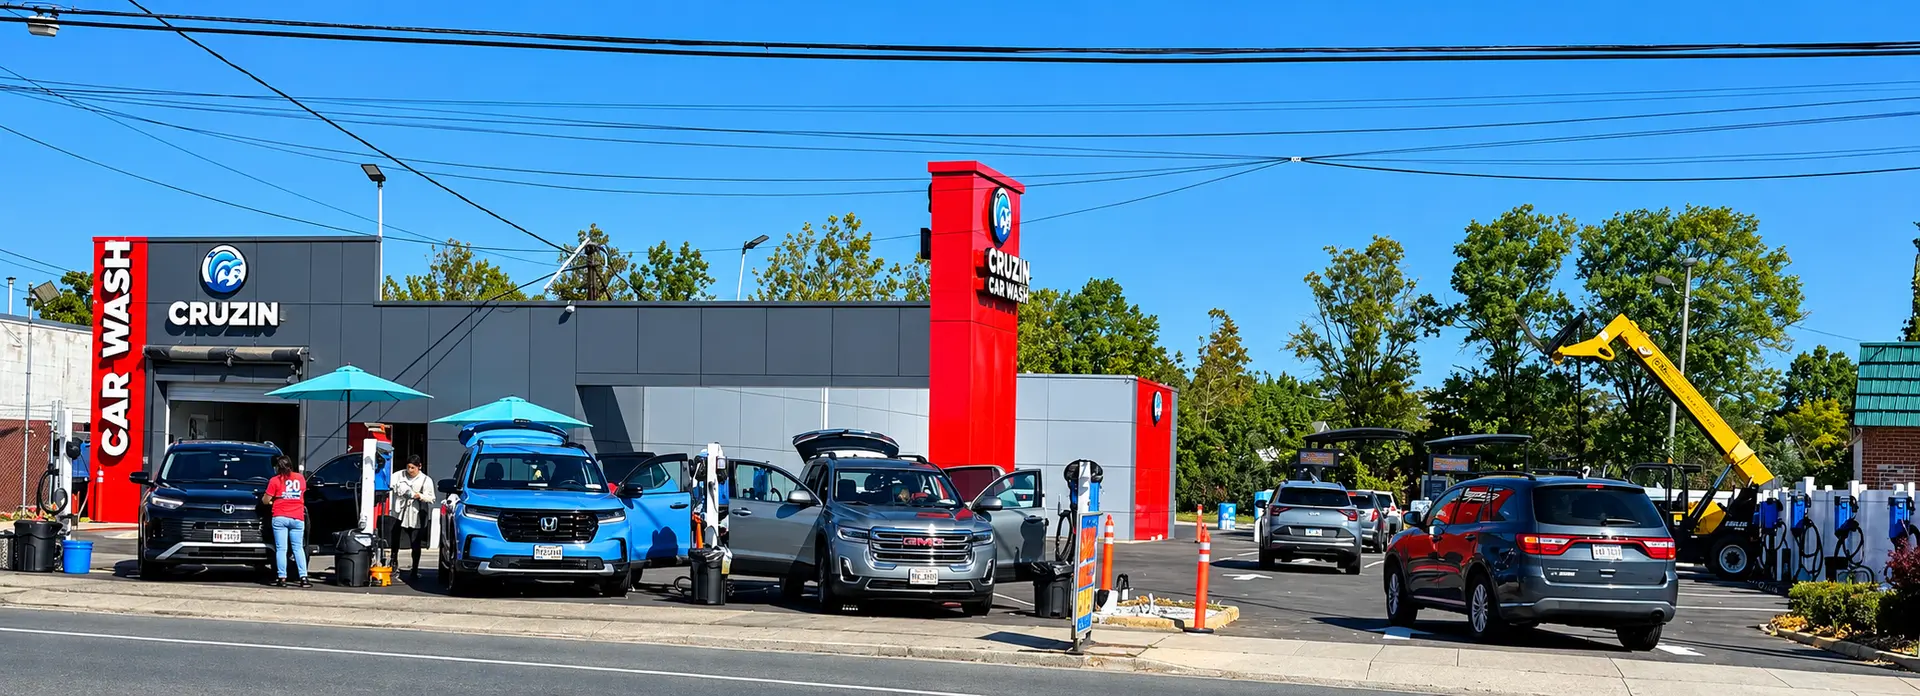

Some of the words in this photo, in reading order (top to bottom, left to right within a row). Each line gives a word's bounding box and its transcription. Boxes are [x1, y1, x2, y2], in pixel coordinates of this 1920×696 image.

[988, 247, 1030, 286] CRUZIN
[103, 241, 131, 357] WASH
[988, 276, 1005, 298] CAR
[1006, 281, 1029, 304] WASH
[168, 301, 279, 326] CRUZIN
[101, 372, 129, 456] CAR
[285, 479, 300, 492] 20
[903, 537, 944, 546] GMC
